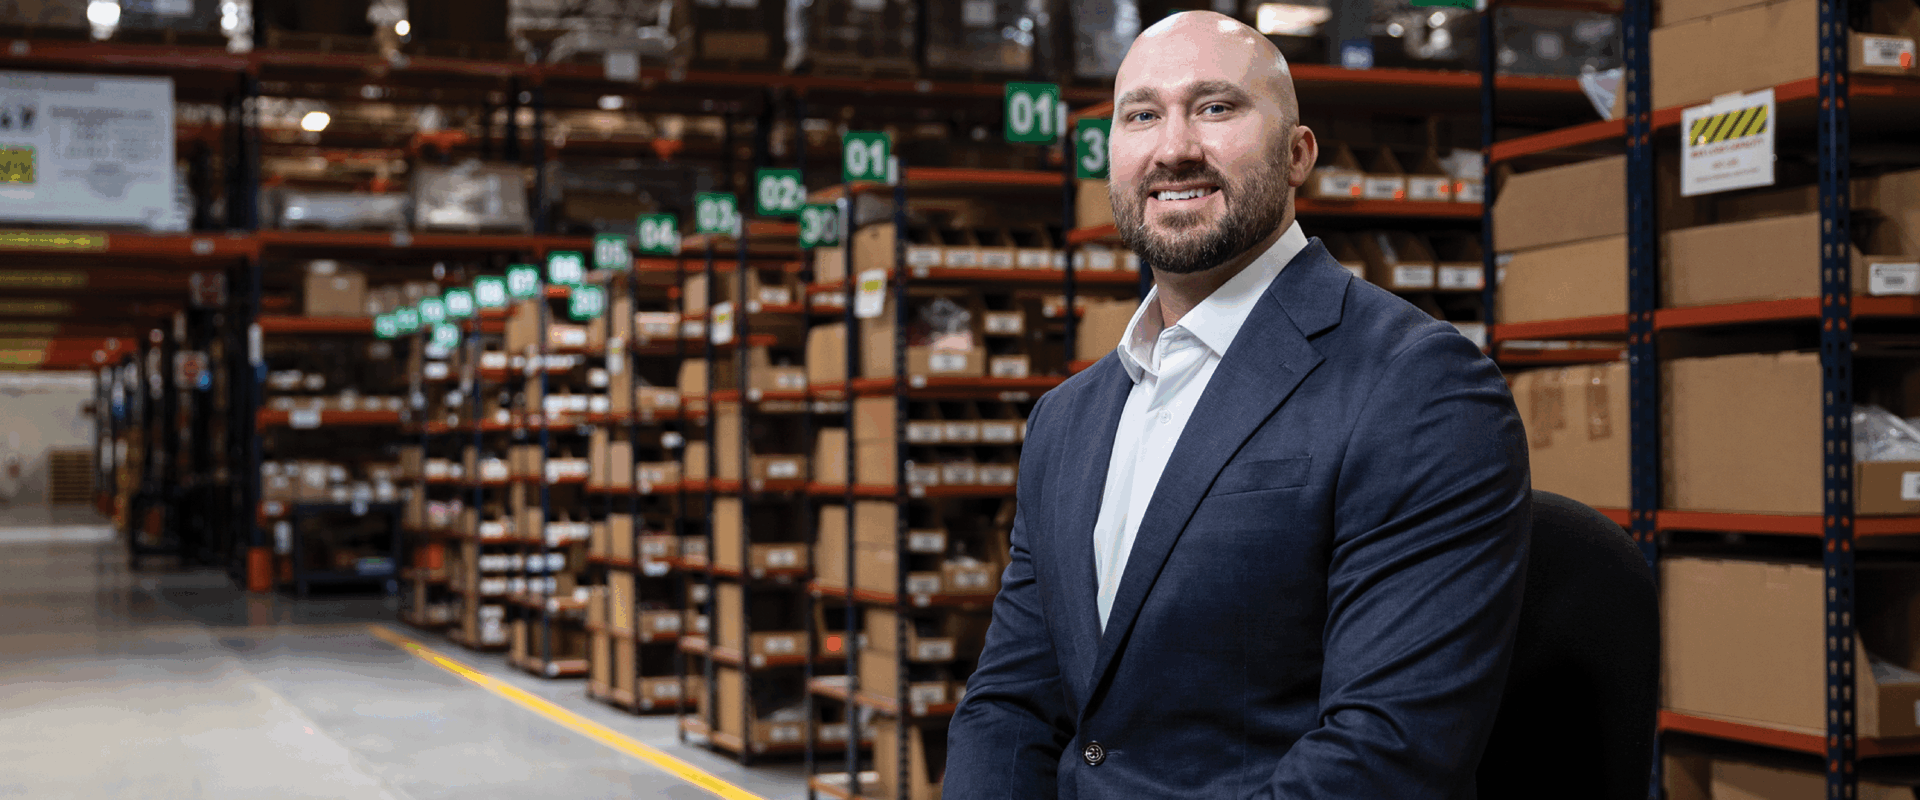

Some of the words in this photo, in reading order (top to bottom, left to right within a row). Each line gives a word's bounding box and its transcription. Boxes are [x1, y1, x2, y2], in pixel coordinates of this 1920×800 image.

[1010, 91, 1053, 135] 01
[844, 139, 886, 177] 01
[1081, 127, 1109, 172] 3
[758, 176, 798, 211] 02
[697, 198, 736, 230] 03
[638, 218, 677, 249] 04
